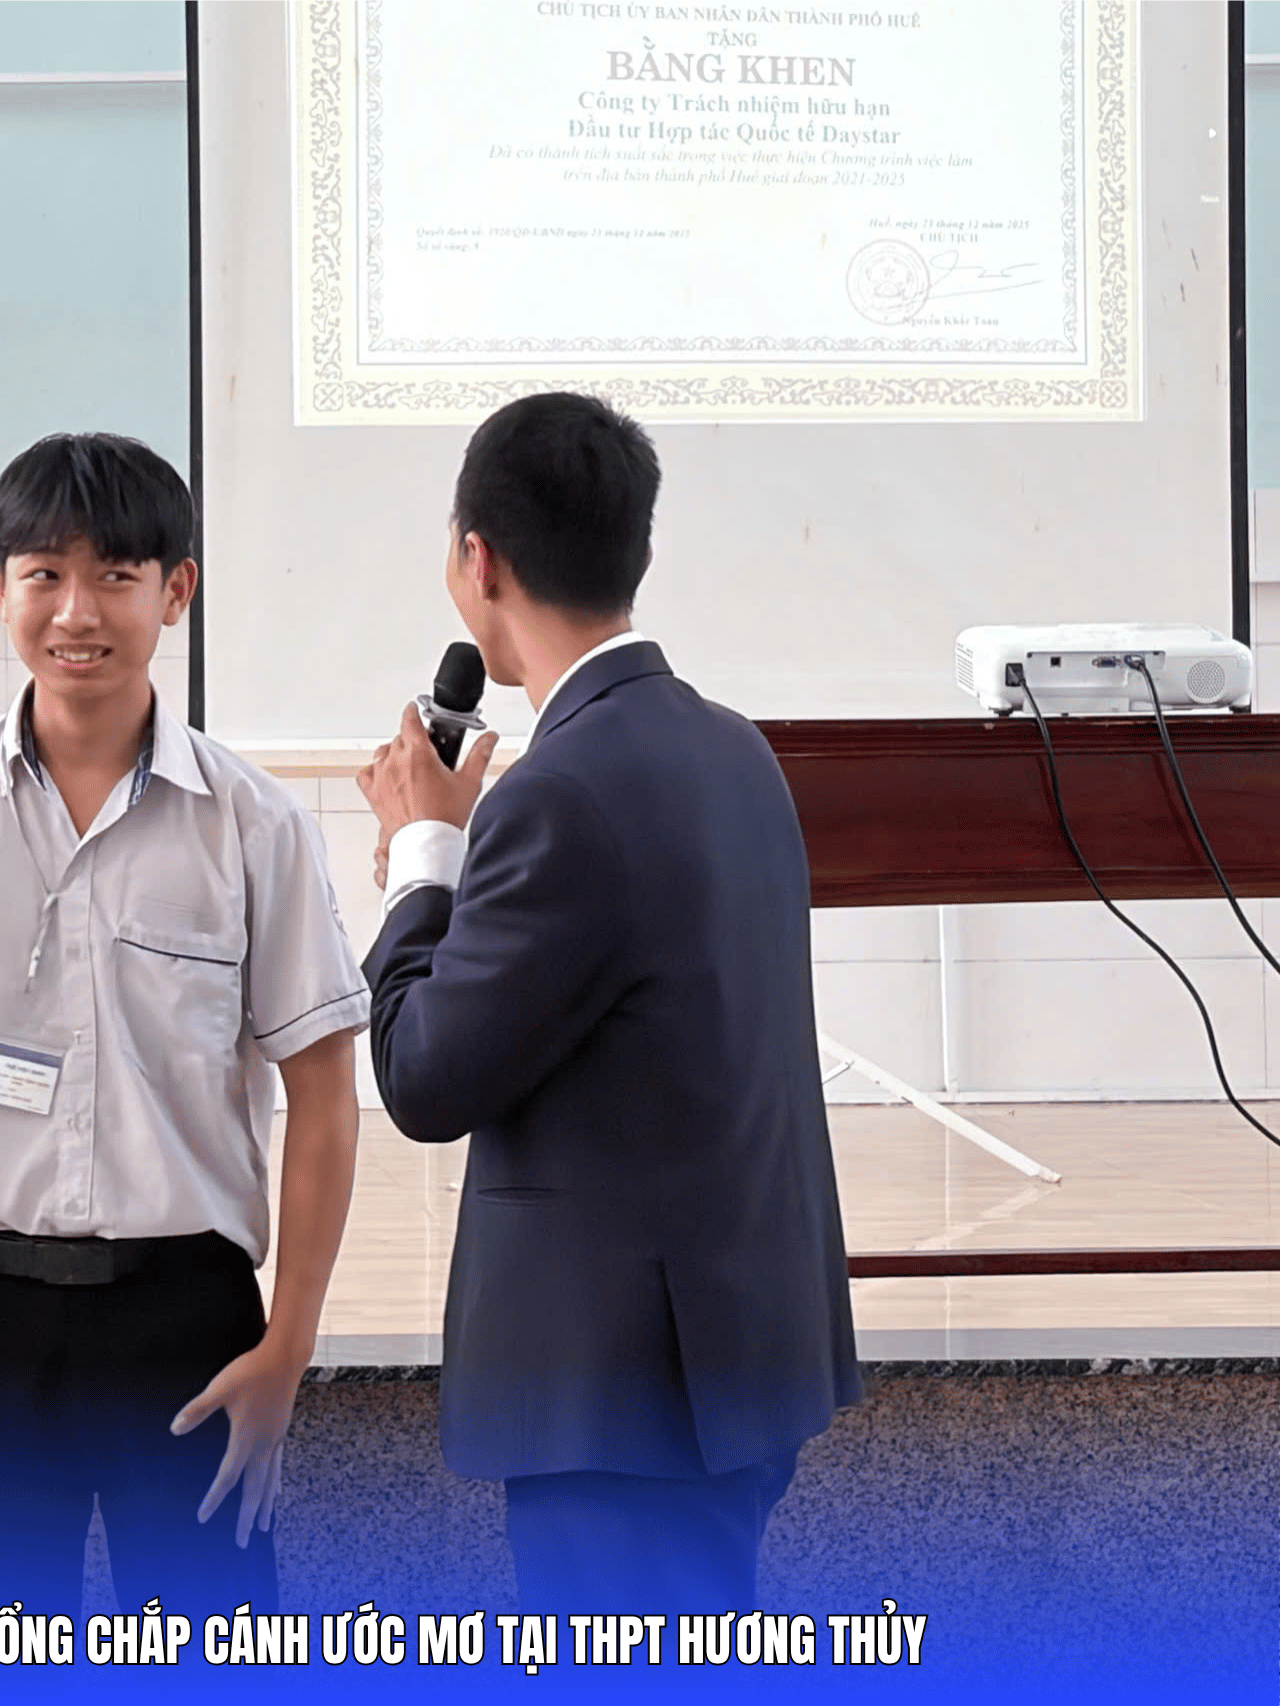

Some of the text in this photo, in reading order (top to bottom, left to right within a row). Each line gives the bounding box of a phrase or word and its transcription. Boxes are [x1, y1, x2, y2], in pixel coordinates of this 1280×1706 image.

[537, 0, 922, 29] CHỦ TỊCH ỦY BAN NHÂN DÂN THÀNH PHỐ HUẾ
[707, 28, 758, 48] TẶNG
[606, 35, 857, 87] BẰNG KHEN
[578, 91, 891, 120] Công ty Trách nhiệm hữu hạn
[568, 114, 901, 148] Đầu tư Hợp tác Quốc tế Daystar
[489, 143, 974, 168] Đã có thành tích xuất sắc trong việc thực hiện Chương trình việc làm
[562, 166, 906, 187] trên địa bàn thành phố Huế giai đoạn 2021-2025
